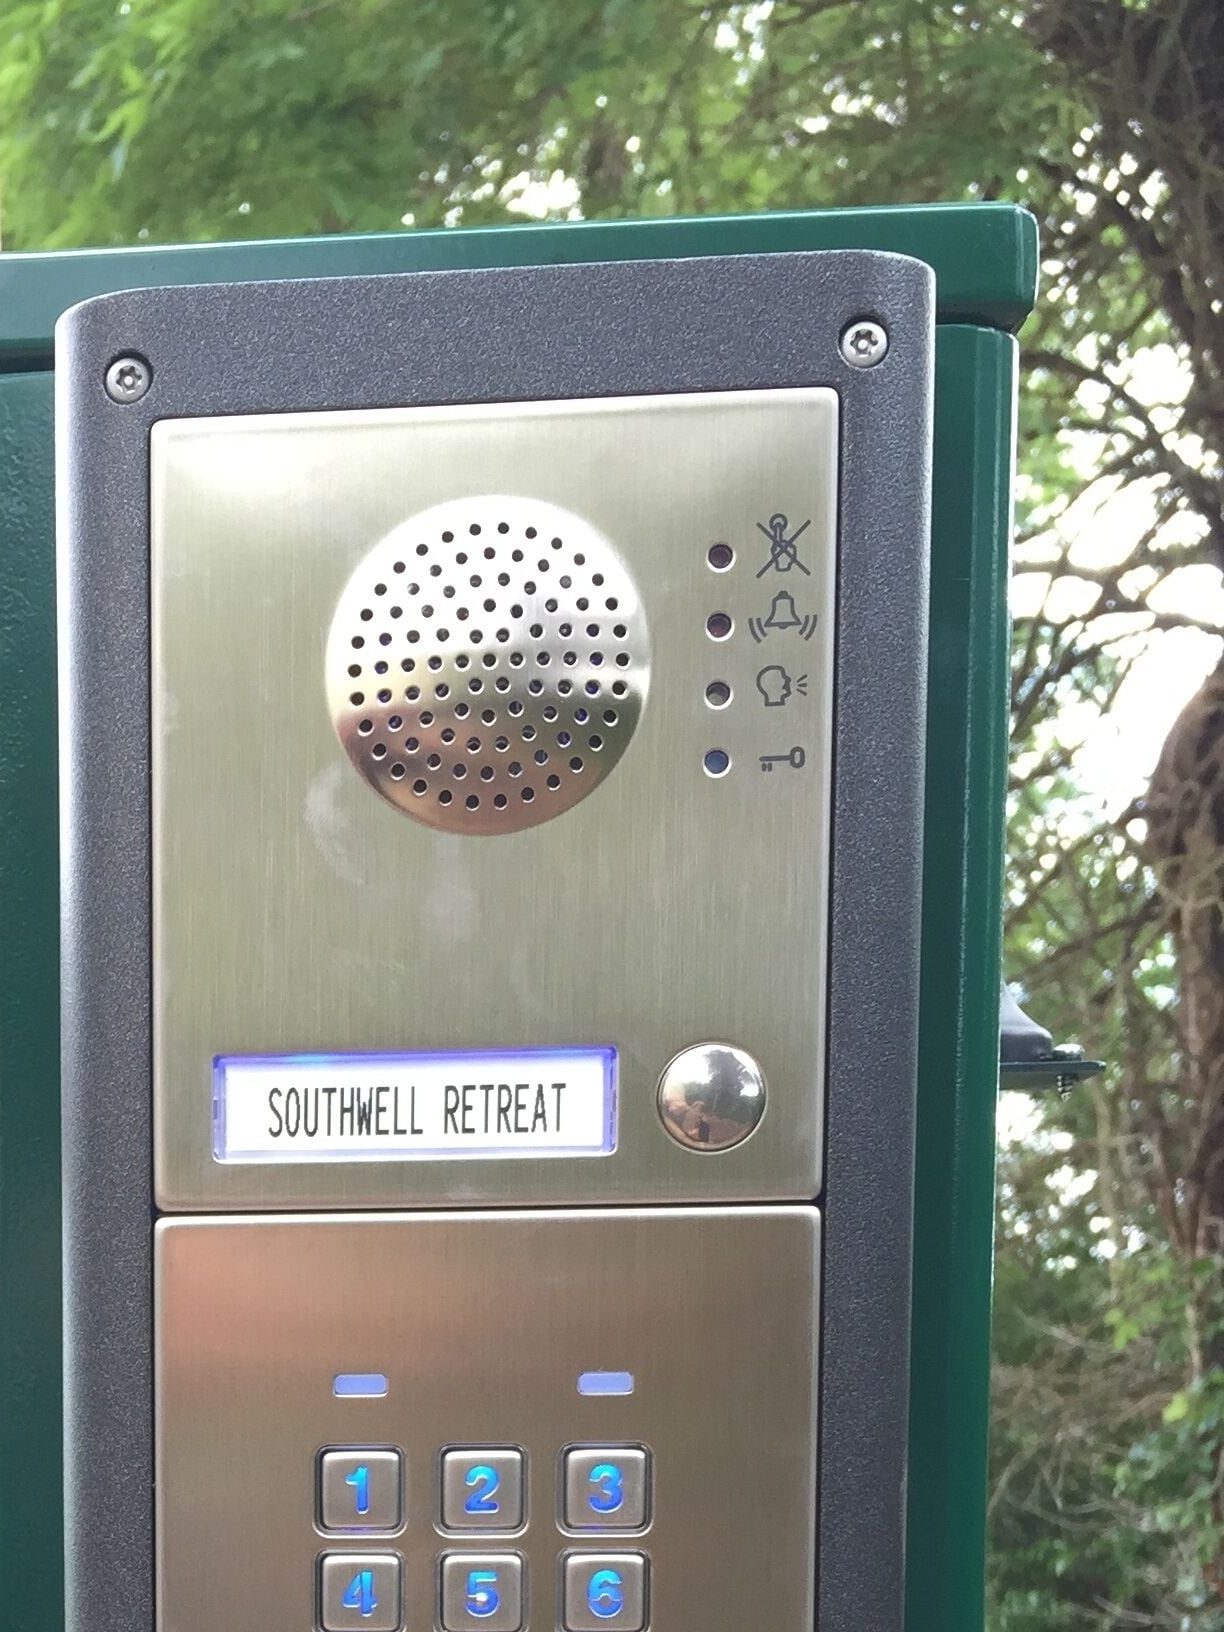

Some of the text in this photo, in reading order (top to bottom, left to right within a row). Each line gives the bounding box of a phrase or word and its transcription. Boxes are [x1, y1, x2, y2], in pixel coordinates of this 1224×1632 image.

[267, 1082, 567, 1138] SOUTHWELL RETREAT
[344, 1465, 369, 1514] 1
[464, 1465, 500, 1513] 2
[588, 1464, 623, 1513] 3
[342, 1570, 377, 1617] 4
[466, 1571, 500, 1617] 5
[586, 1569, 623, 1618] 6
